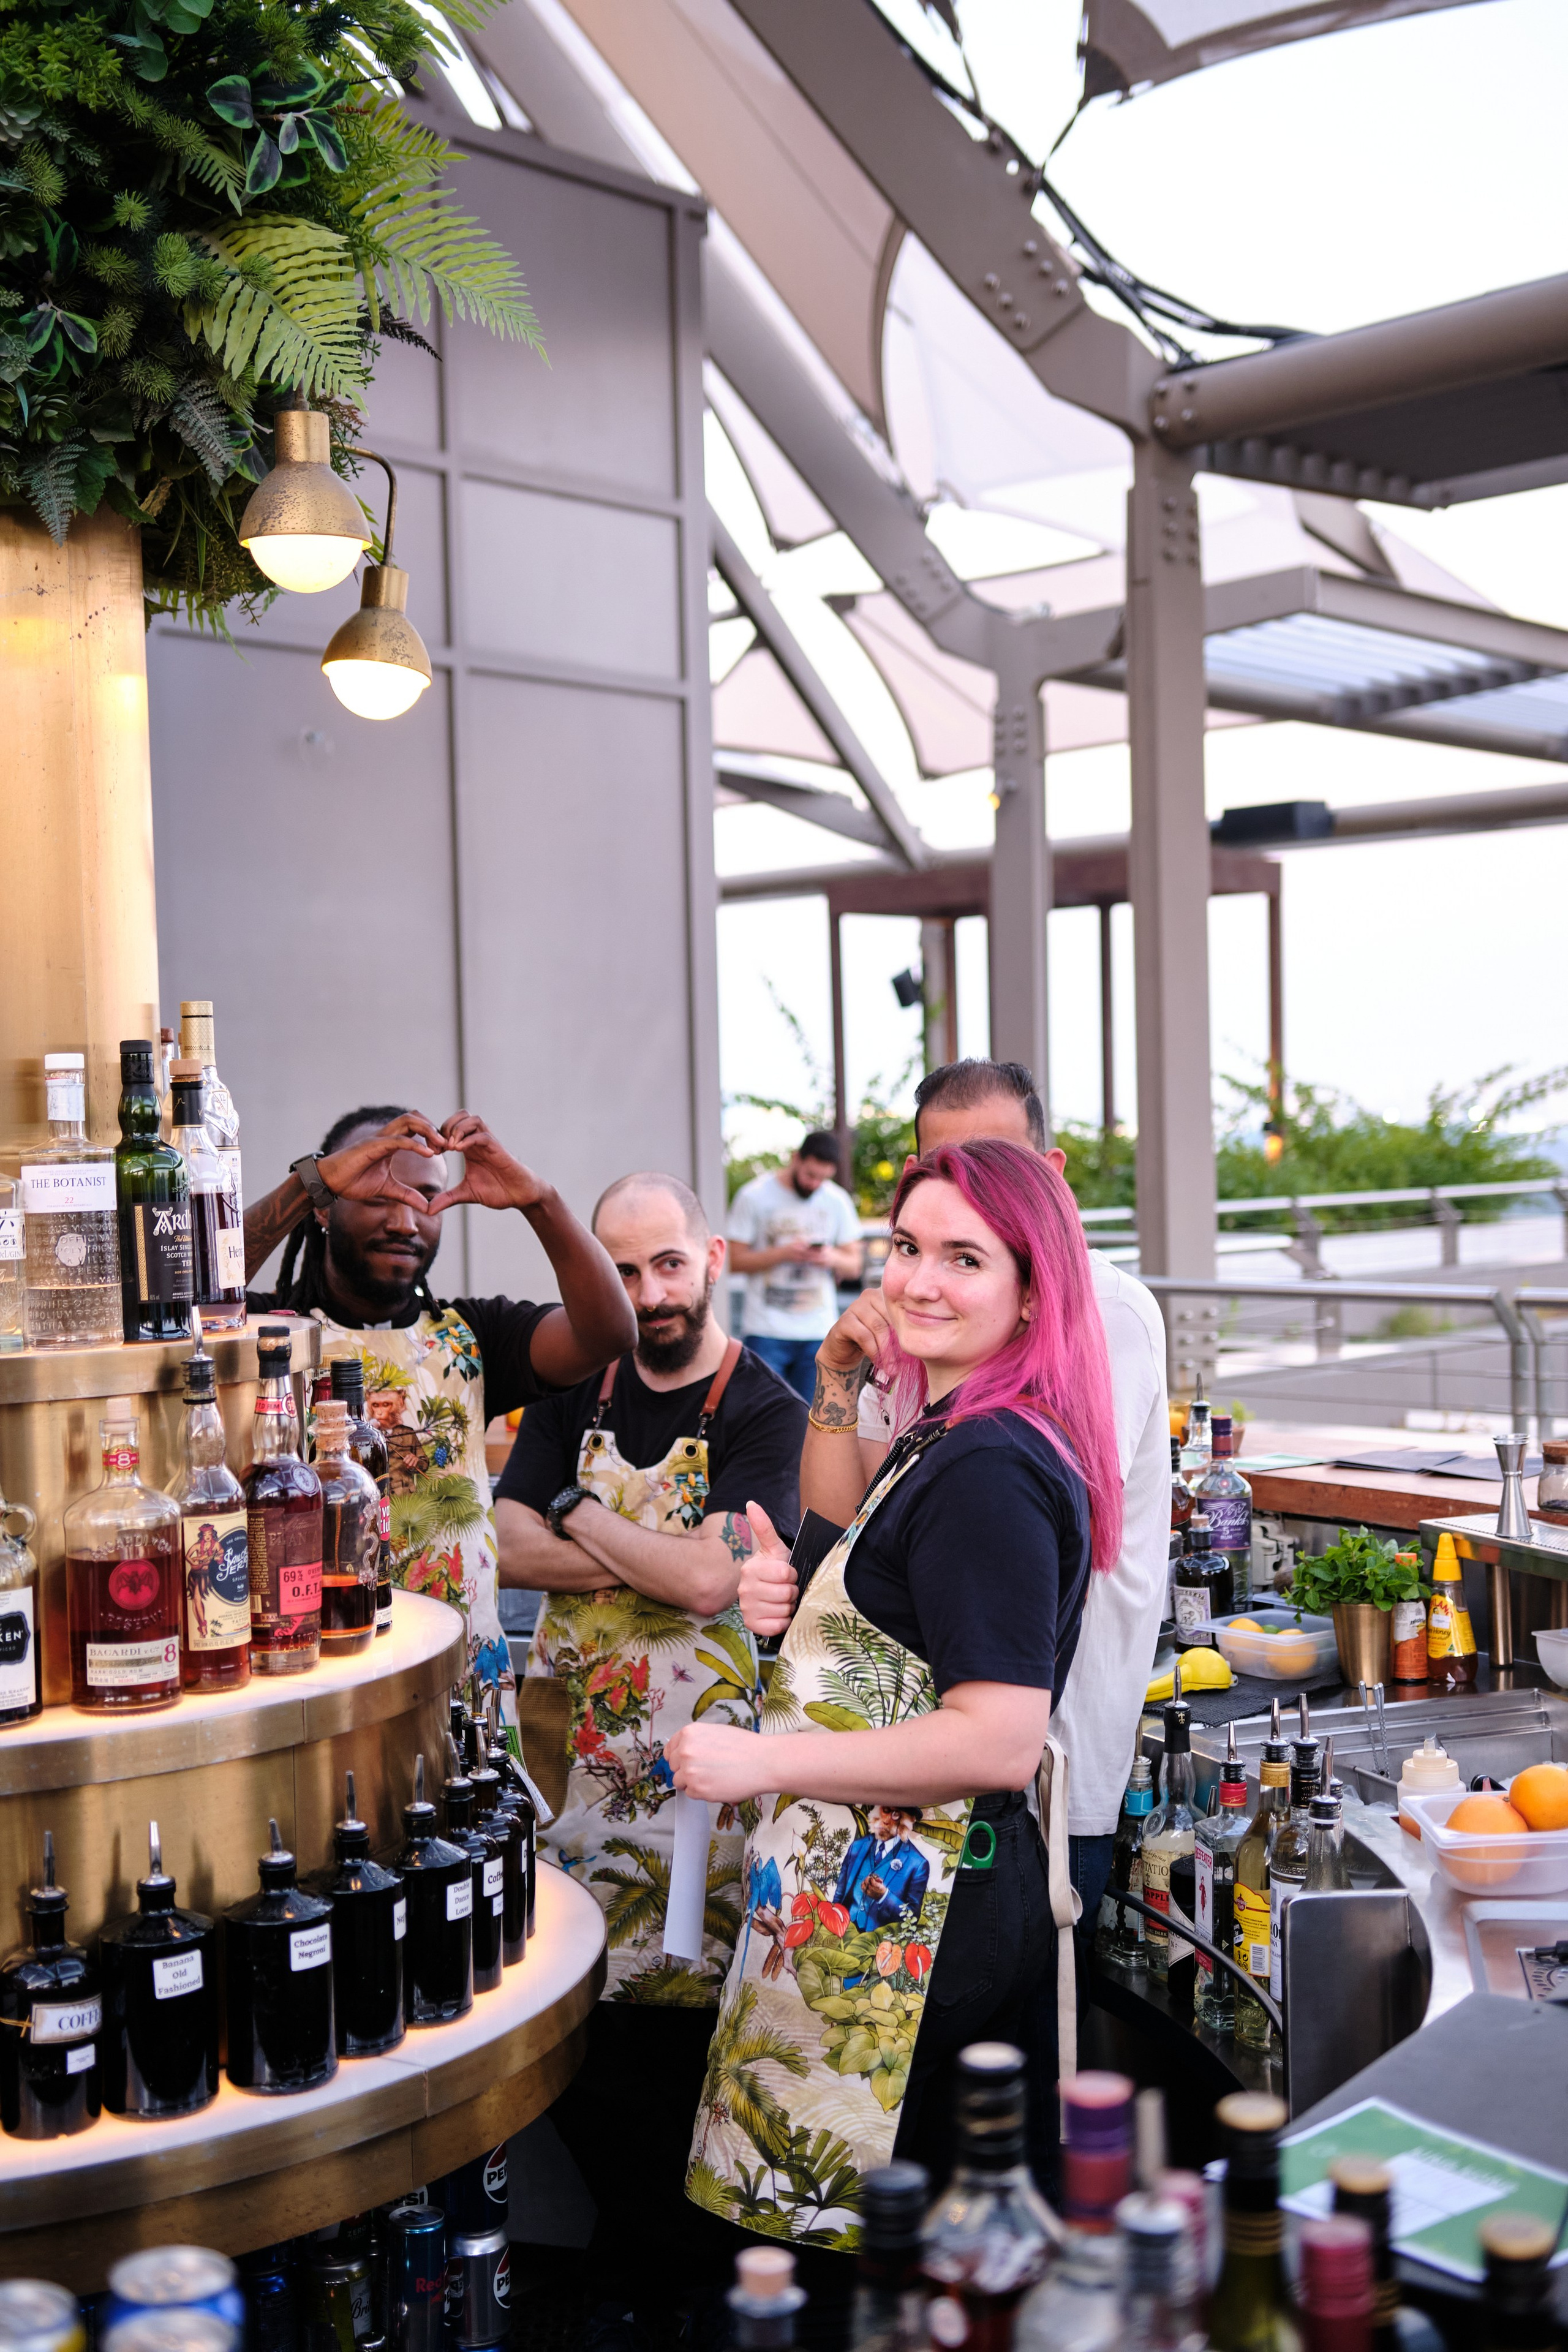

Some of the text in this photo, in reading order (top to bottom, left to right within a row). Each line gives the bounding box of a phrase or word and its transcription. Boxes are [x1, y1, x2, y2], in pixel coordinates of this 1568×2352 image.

[31, 1177, 107, 1189] THE BOTANIST
[118, 1453, 130, 1466] 8
[1205, 1509, 1249, 1529] Banks
[284, 1571, 296, 1583] 69
[1434, 1627, 1450, 1639] Honey
[90, 1648, 140, 1656] BACARDI
[164, 1643, 176, 1663] 8
[453, 1881, 470, 1893] Double
[454, 1894, 469, 1904] Dance
[456, 1905, 469, 1916] Lover
[294, 1934, 328, 1948] Chocolate
[298, 1944, 326, 1959] Negroni
[162, 1956, 194, 1969] Banana
[172, 1968, 187, 1979] Old
[158, 1975, 200, 1995] Fashioned
[347, 2226, 366, 2237] ZERO
[415, 2276, 443, 2294] Red
